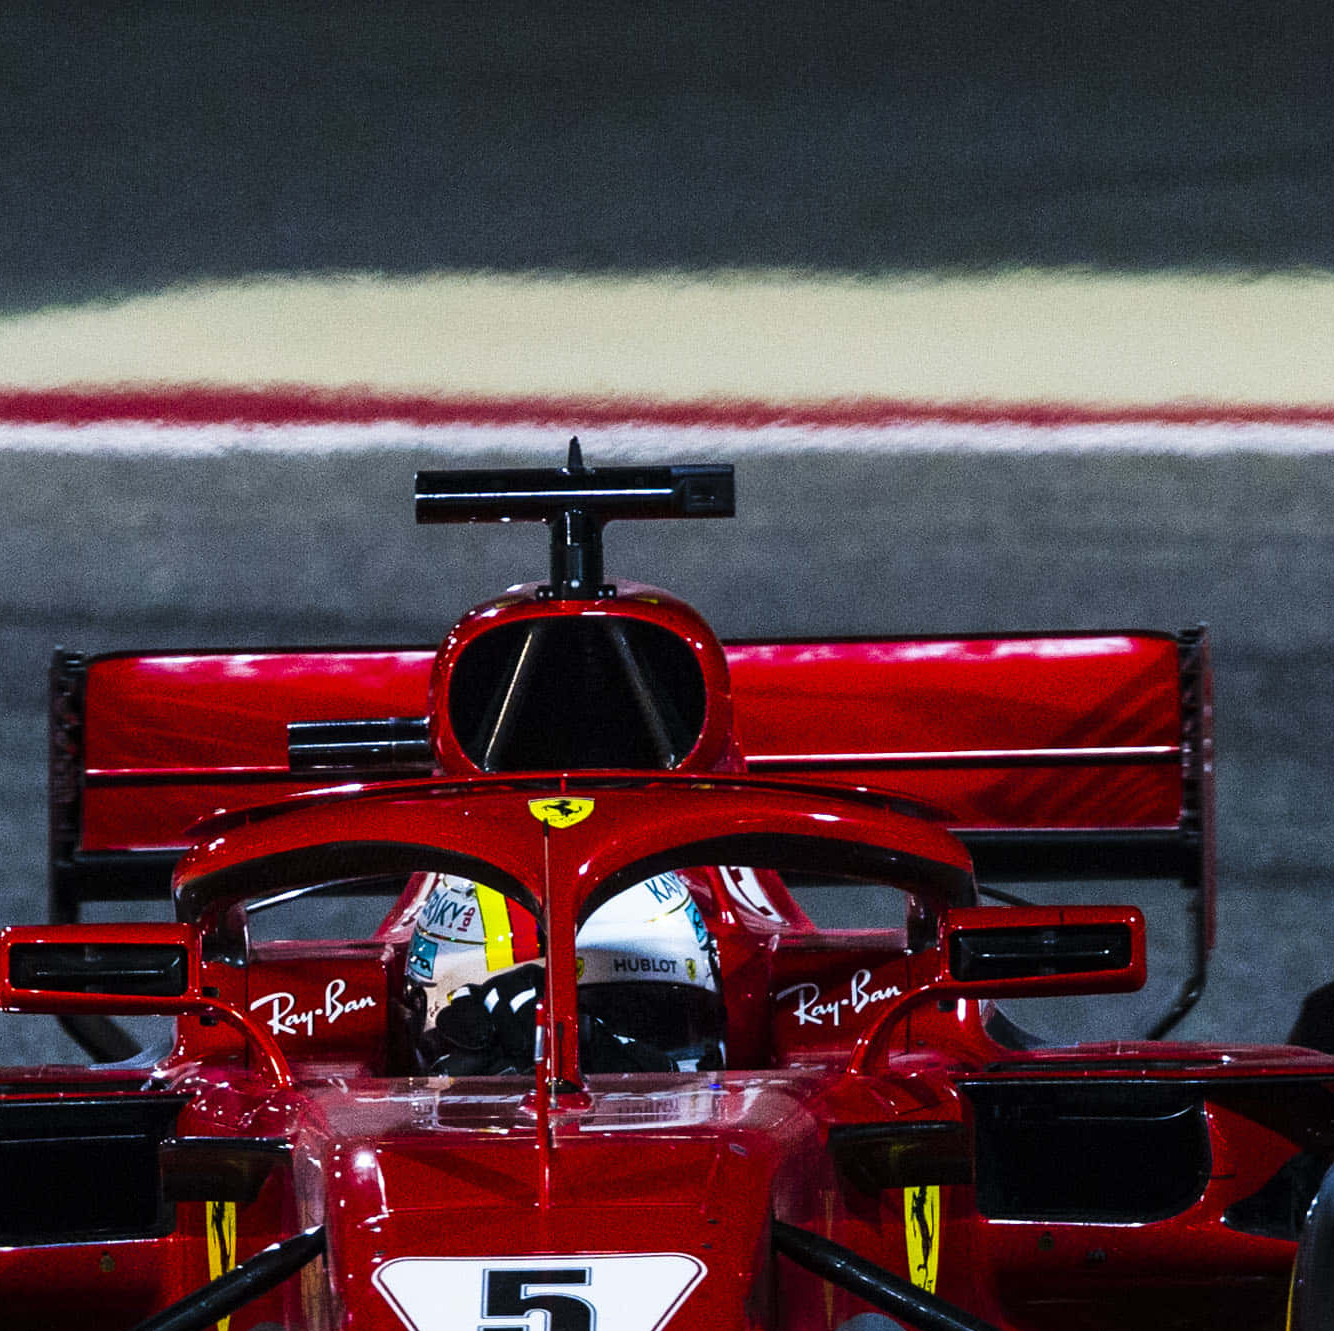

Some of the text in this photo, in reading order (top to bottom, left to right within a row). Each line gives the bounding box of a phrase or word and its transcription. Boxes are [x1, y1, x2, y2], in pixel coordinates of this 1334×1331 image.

[613, 958, 677, 973] HUBLOT
[250, 978, 378, 1036] Ray-Ban
[776, 968, 903, 1026] Ray-Ban
